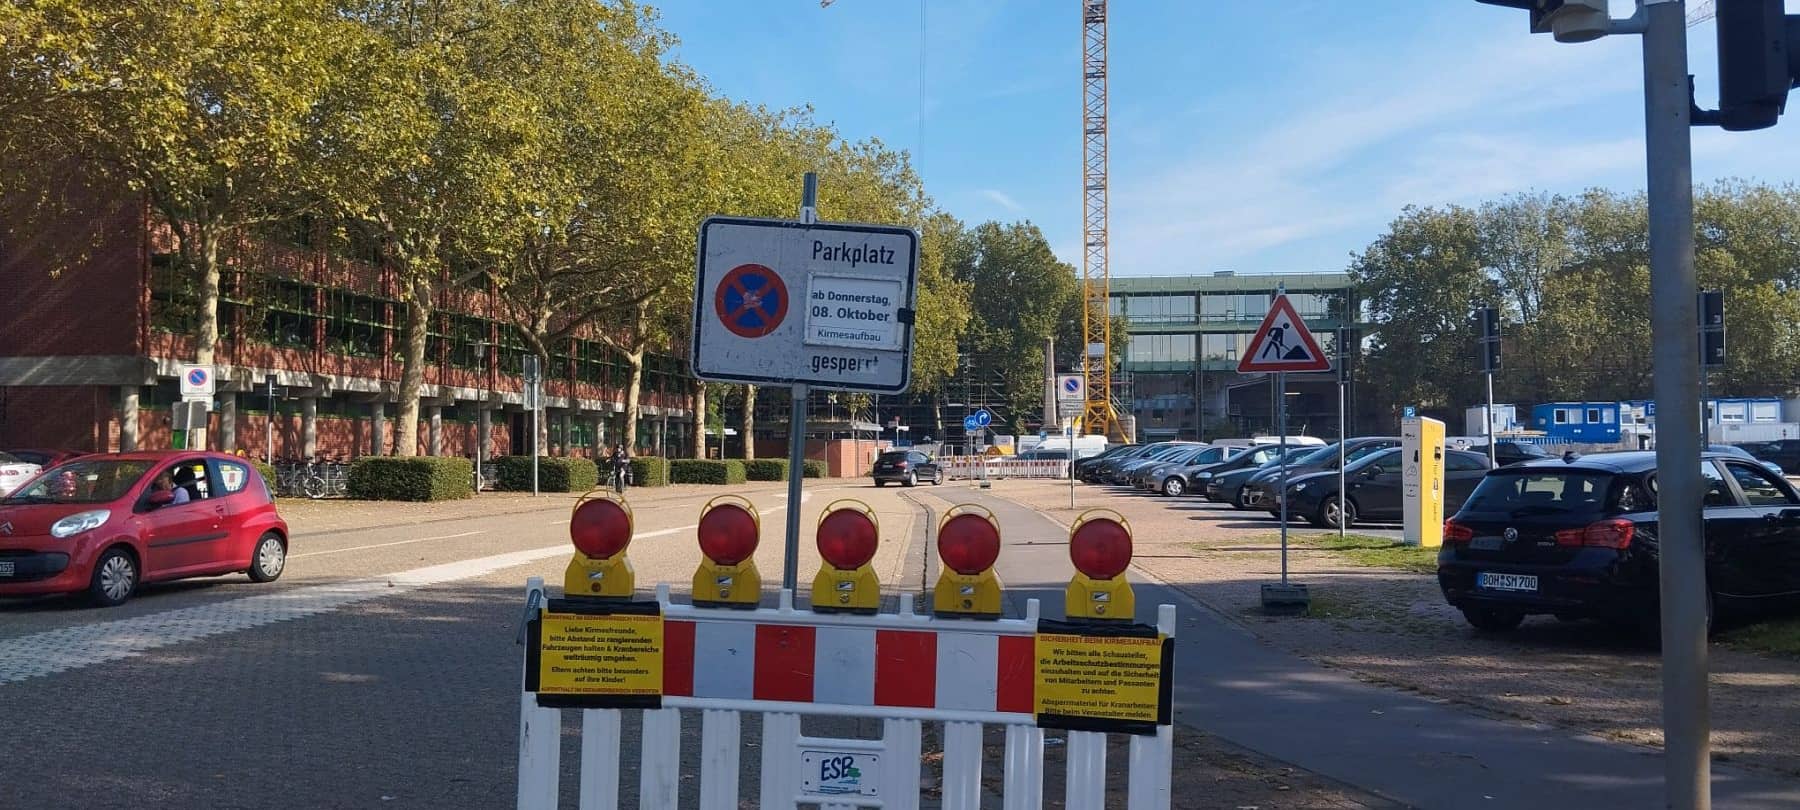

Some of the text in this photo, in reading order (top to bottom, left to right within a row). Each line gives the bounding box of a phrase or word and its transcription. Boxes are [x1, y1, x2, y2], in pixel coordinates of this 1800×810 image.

[812, 240, 895, 268] Parkplatz
[812, 291, 891, 306] ab Donnerstag,
[812, 306, 890, 322] 08. Oktober
[818, 330, 881, 342] Kirmesaufbau
[1483, 574, 1536, 588] BOH SM 700
[1102, 651, 1148, 660] Schausteller,
[821, 756, 854, 781] ESB
